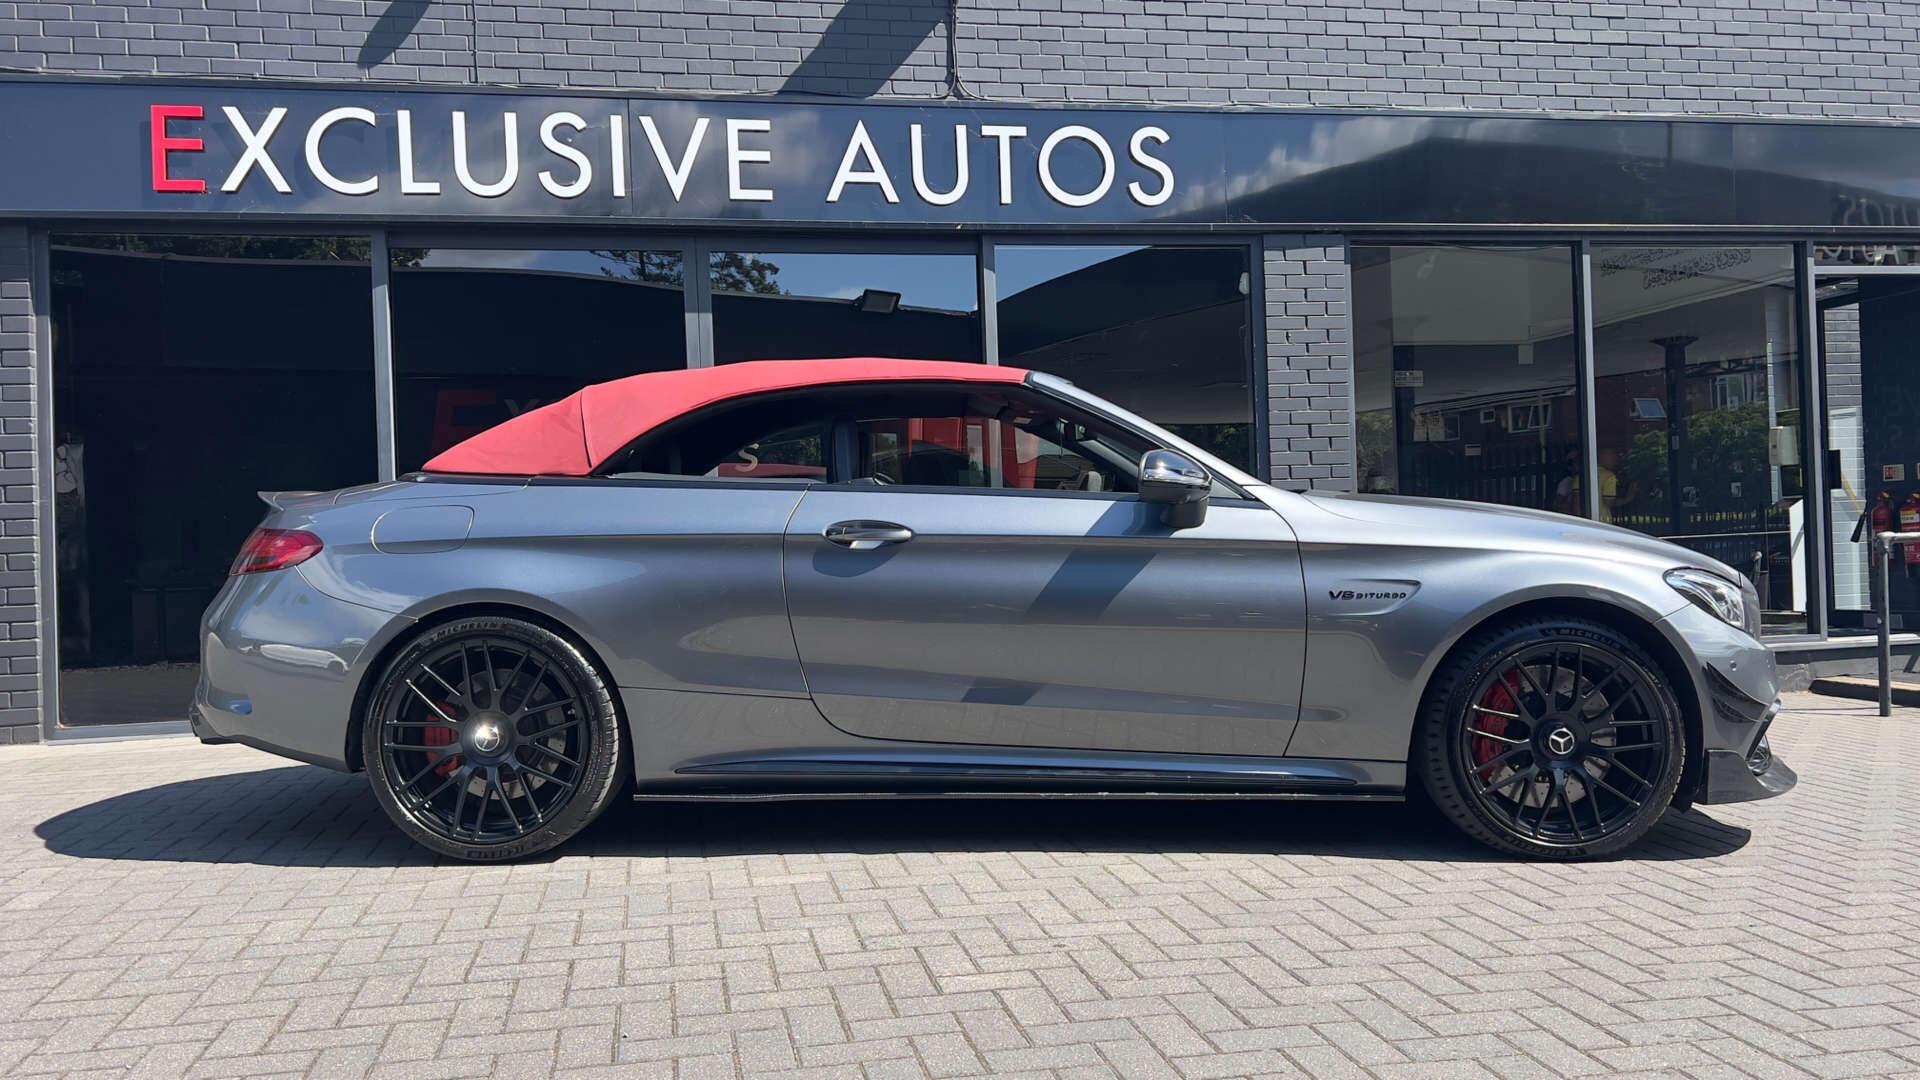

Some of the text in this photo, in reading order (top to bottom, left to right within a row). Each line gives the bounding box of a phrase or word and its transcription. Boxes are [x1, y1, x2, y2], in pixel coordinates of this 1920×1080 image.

[150, 105, 1175, 207] EXCLUSIVE AUTOS
[1328, 590, 1407, 601] V8 BITURBO
[437, 622, 497, 639] MICHELIN
[1560, 628, 1623, 649] MICHELIN
